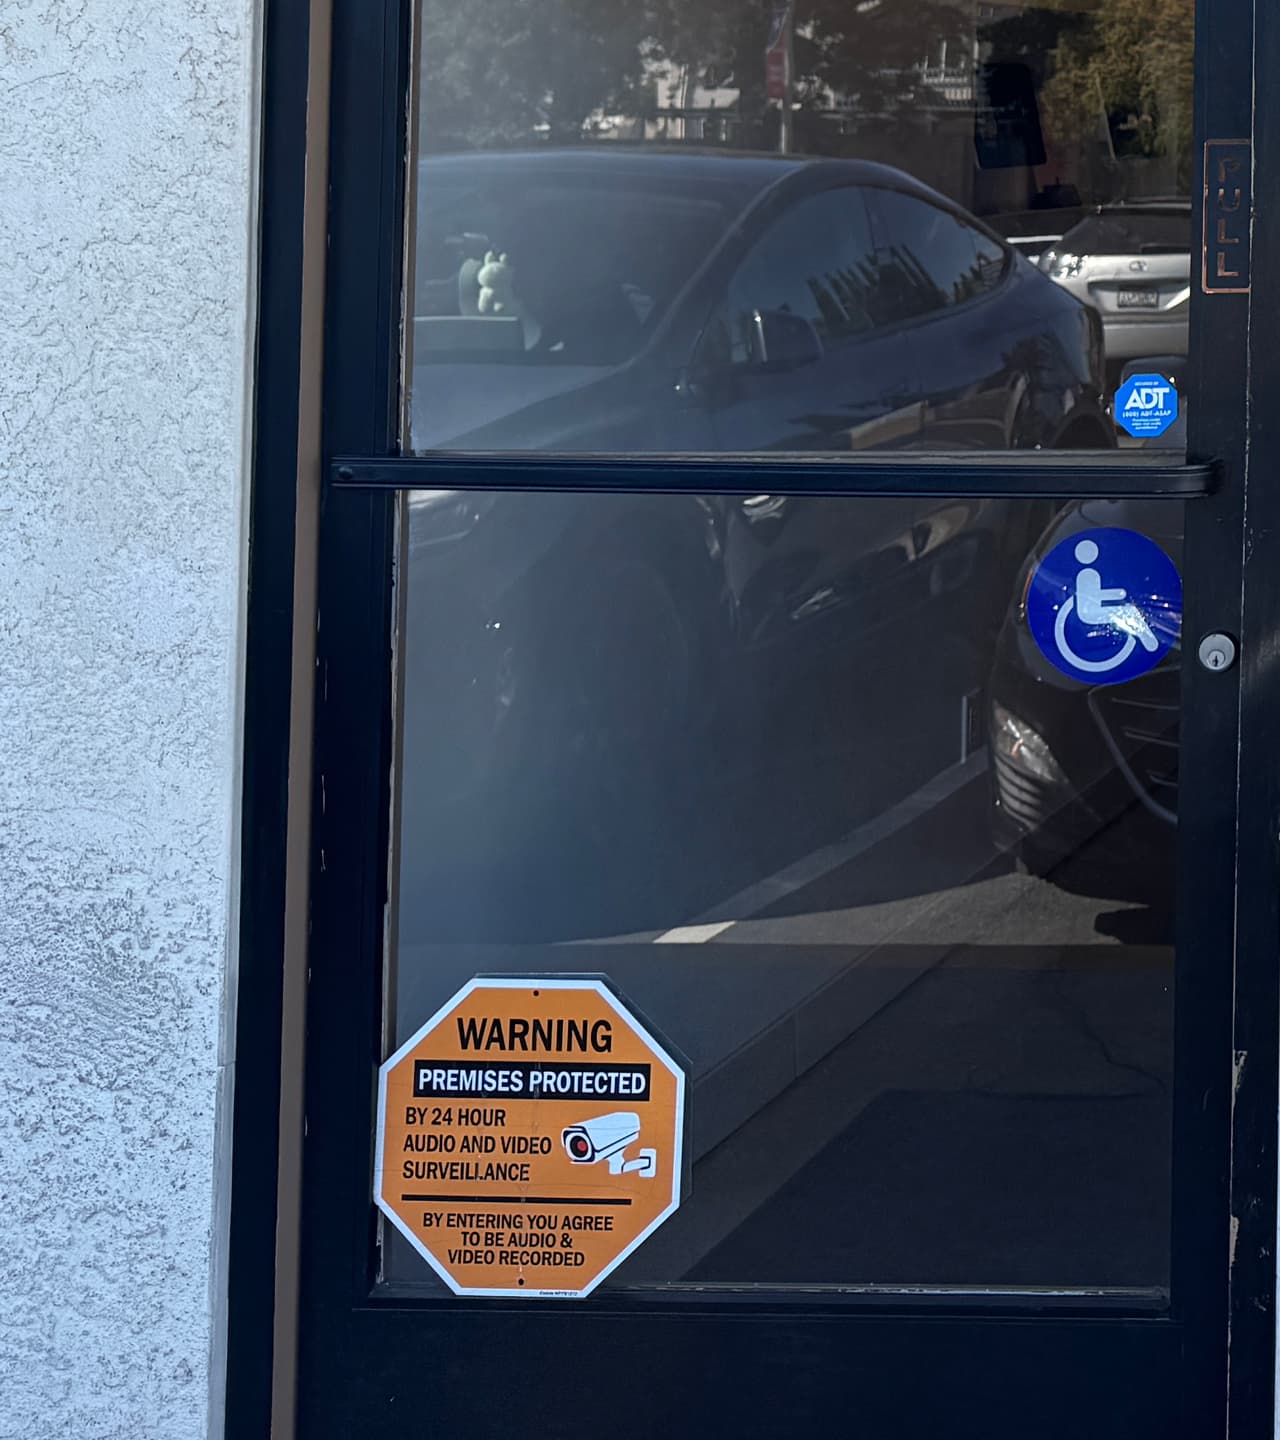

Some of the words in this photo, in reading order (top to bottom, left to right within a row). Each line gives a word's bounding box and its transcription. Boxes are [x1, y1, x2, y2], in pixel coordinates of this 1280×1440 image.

[1217, 159, 1240, 277] PULL
[1124, 387, 1170, 410] ADT
[457, 1017, 612, 1053] WARNING
[418, 1069, 523, 1092] PREMISES
[529, 1071, 646, 1094] PROTECTED
[405, 1107, 427, 1125] BY
[431, 1108, 452, 1125] 24
[458, 1109, 506, 1126] HOUR
[403, 1134, 455, 1153] AUDIO
[460, 1135, 496, 1153] AND
[501, 1136, 552, 1154] VIDEO
[402, 1160, 530, 1182] SURVEILLANCE
[423, 1213, 443, 1227] BY
[447, 1213, 523, 1229] ENTERING
[526, 1214, 558, 1230] YOU
[561, 1215, 613, 1231] AGREE
[461, 1231, 480, 1246] TO
[484, 1232, 504, 1247] BE
[507, 1232, 556, 1248] AUDIO
[560, 1234, 573, 1248] &
[447, 1249, 494, 1265] VIDEO
[498, 1250, 585, 1266] RECORDED
